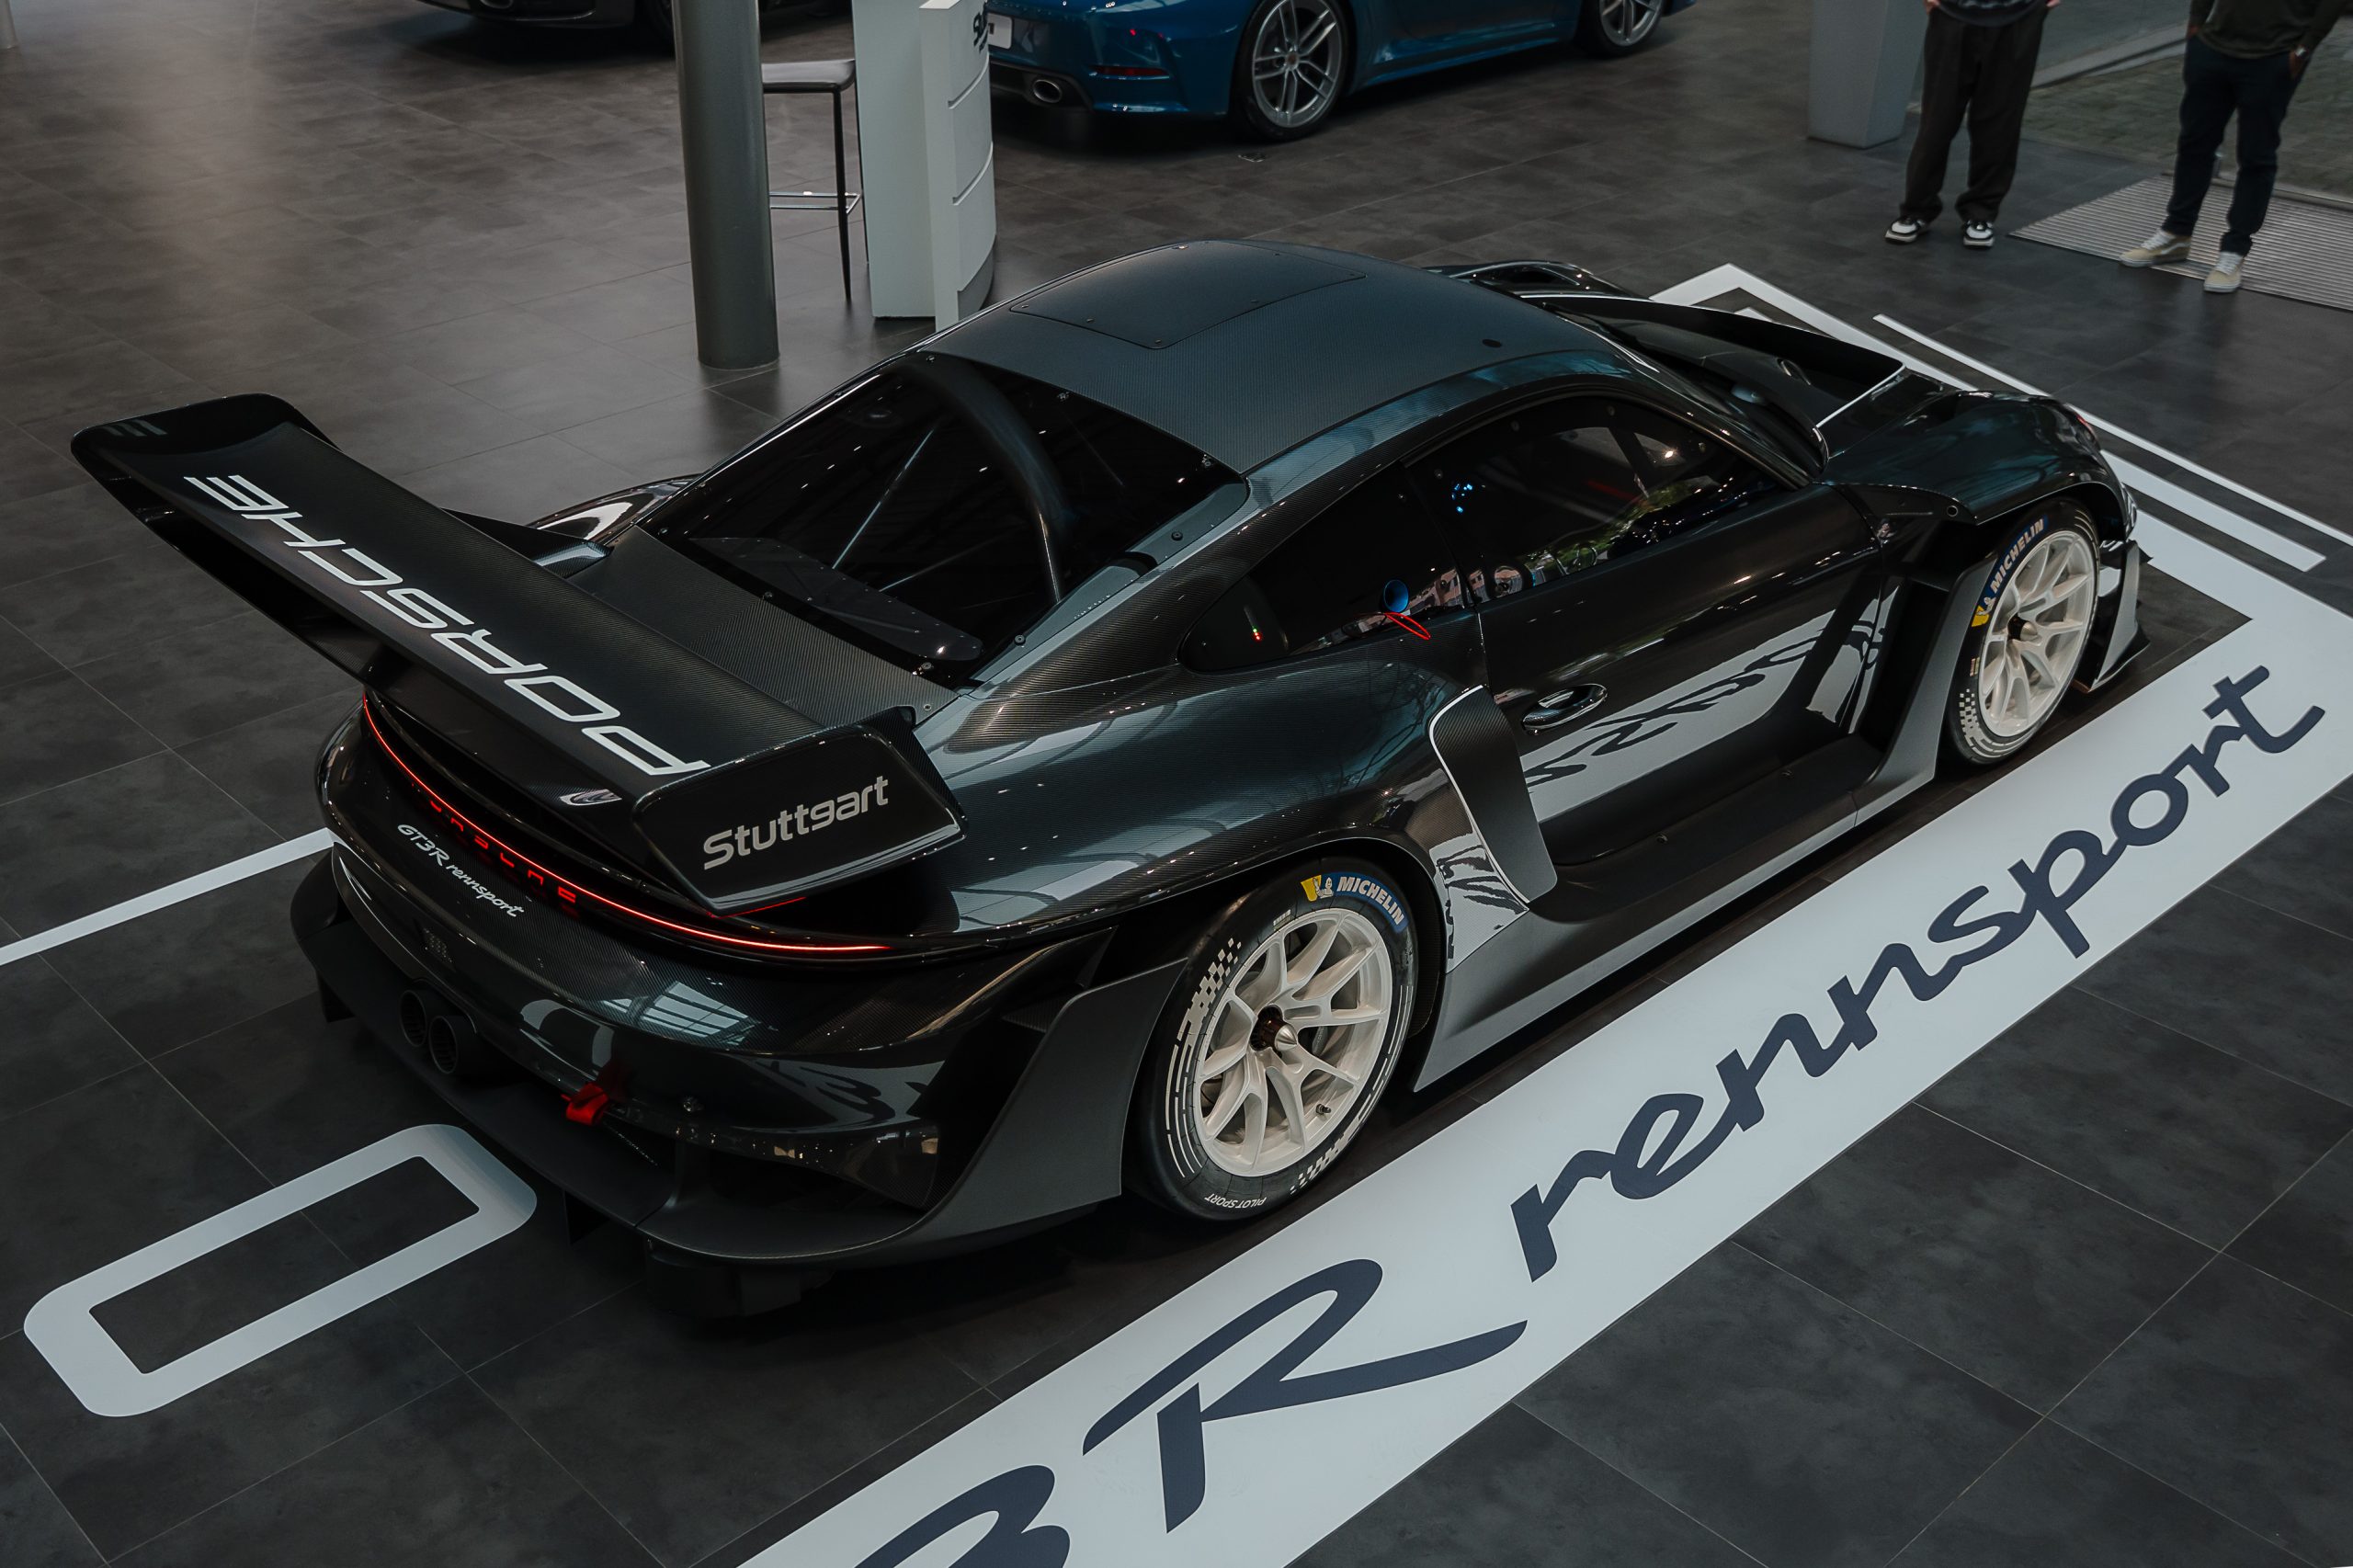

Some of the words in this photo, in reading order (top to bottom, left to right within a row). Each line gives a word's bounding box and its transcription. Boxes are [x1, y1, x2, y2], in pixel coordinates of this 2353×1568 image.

[1990, 518, 2044, 594] MICHELIN
[185, 474, 711, 776] PORSCHE
[703, 776, 889, 870] Stuttgart
[397, 824, 450, 867] GT3R
[446, 864, 525, 917] rennsport
[1336, 876, 1404, 925] MICHELIN
[1510, 665, 2326, 1283] rennsport
[1204, 1193, 1238, 1209] SPORT
[1234, 1197, 1267, 1209] PILOT
